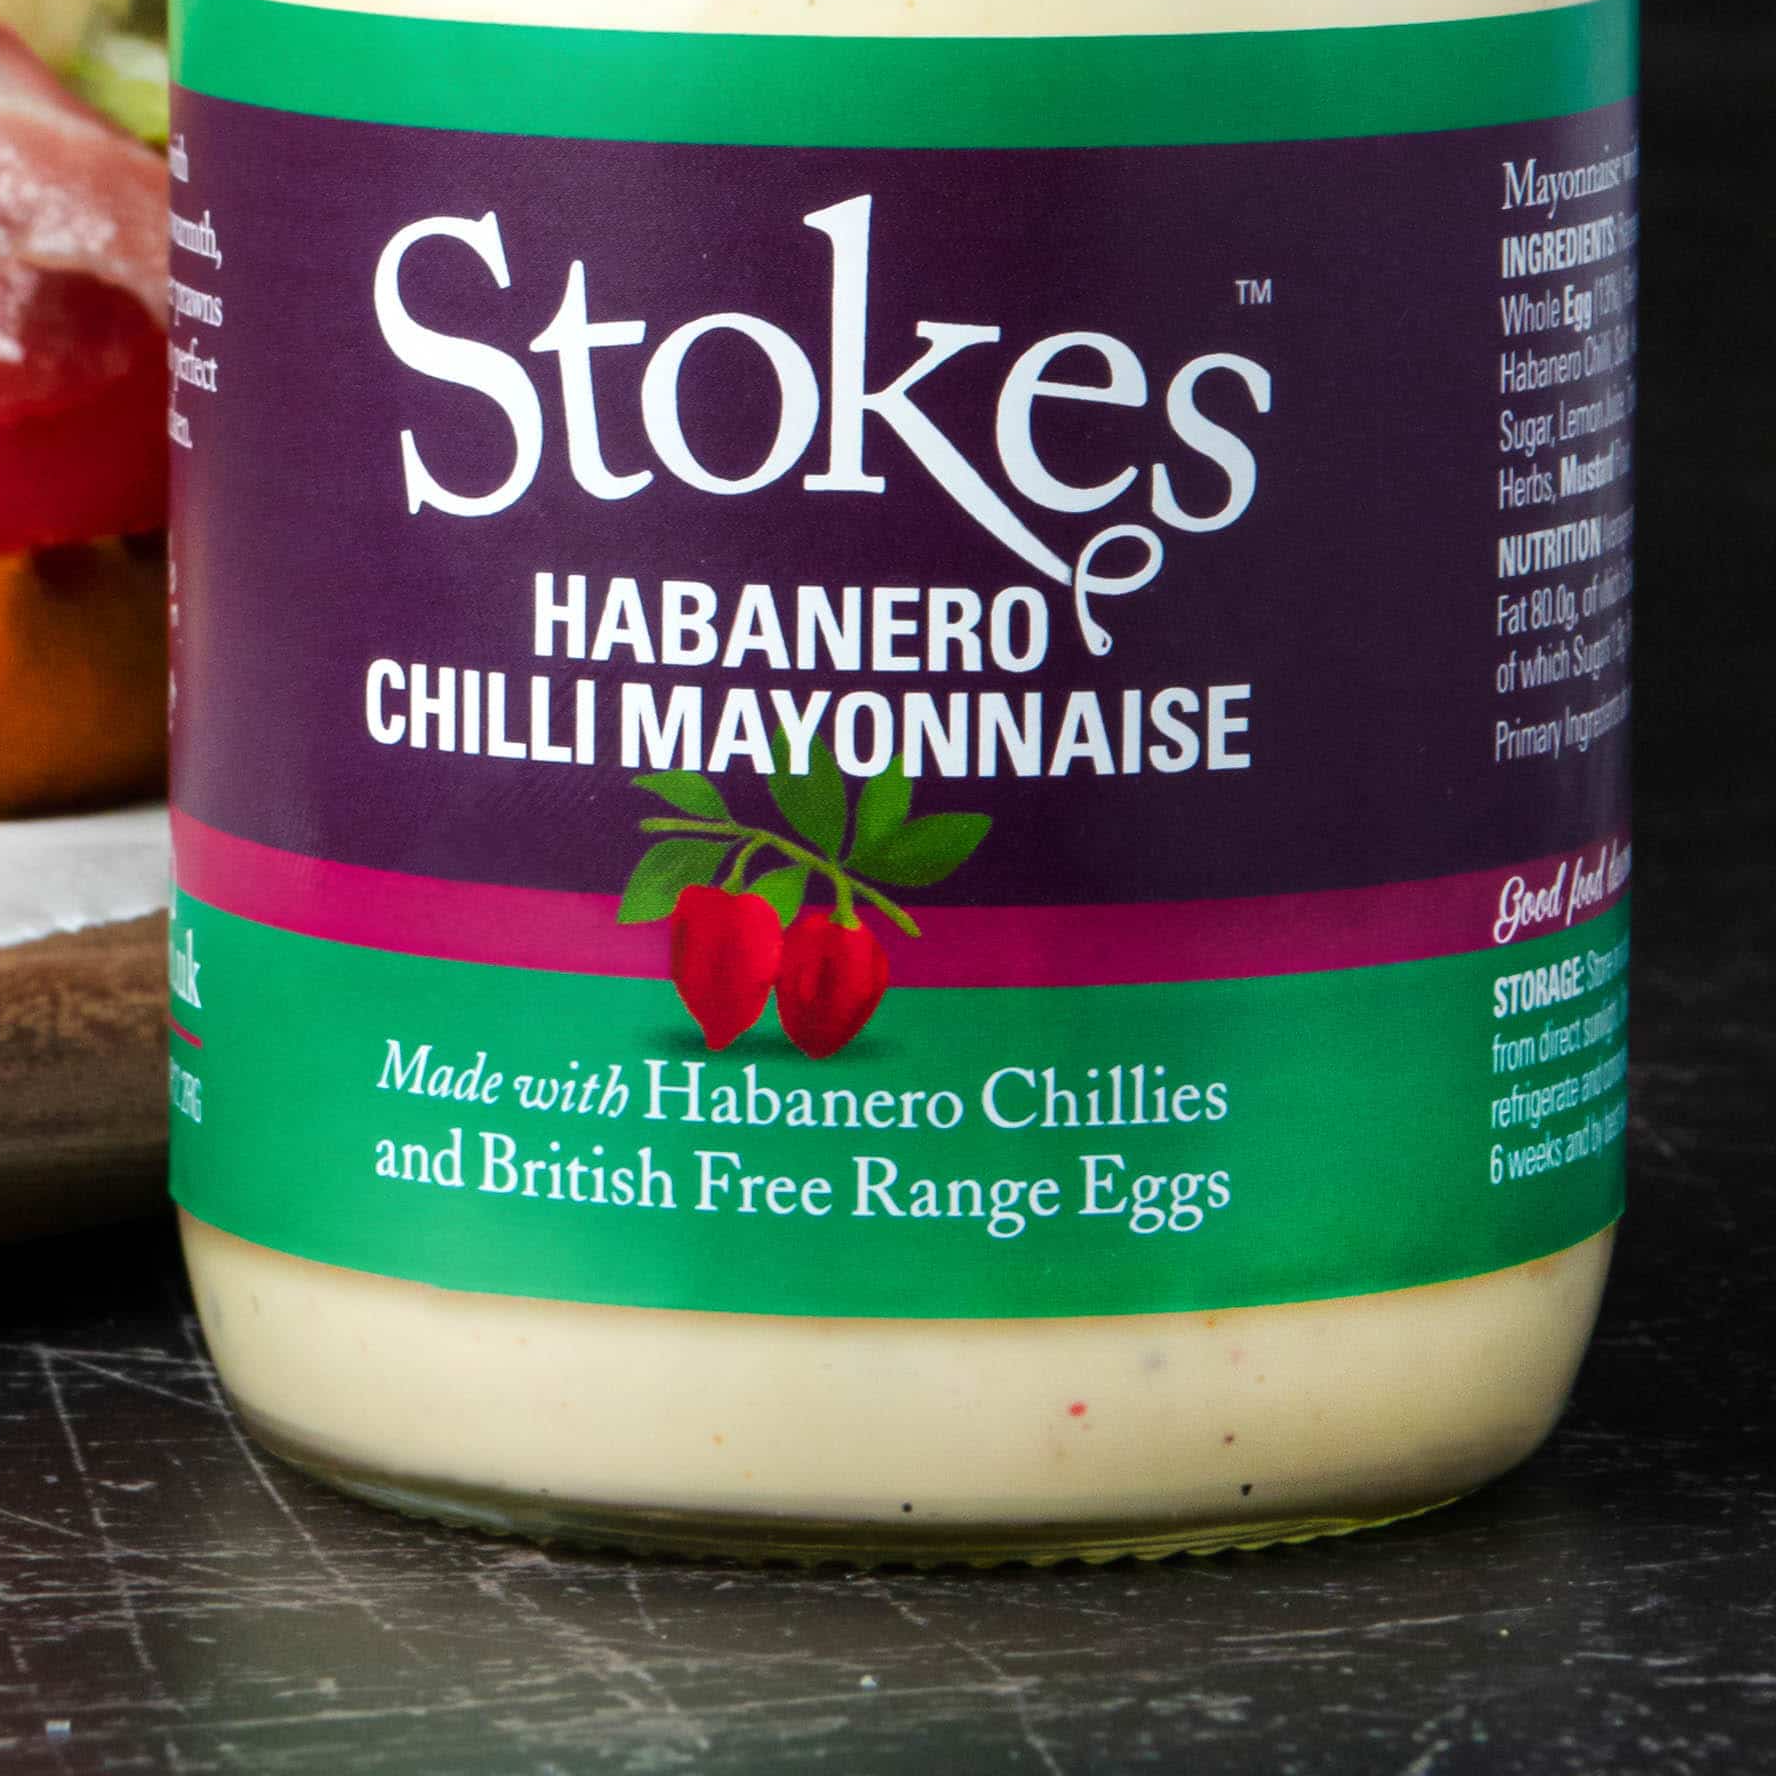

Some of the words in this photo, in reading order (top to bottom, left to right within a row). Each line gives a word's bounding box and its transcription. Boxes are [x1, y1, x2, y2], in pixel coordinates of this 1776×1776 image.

[1500, 144, 1621, 220] Mayonnaise
[1499, 289, 1561, 337] Whole
[1563, 284, 1593, 333] Egg
[1499, 348, 1582, 395] Habanero
[373, 193, 1272, 657] Stokes
[1499, 409, 1556, 458] Sugar,
[1498, 463, 1557, 511] Herbs,
[1497, 516, 1602, 578] NUTRITION
[532, 571, 1050, 674] HABANERO
[1496, 594, 1528, 637] Fat
[1496, 650, 1518, 694] of
[1520, 639, 1570, 690] which
[364, 657, 595, 766] CHILLI
[622, 683, 1252, 778] MAYONNAISE
[1495, 716, 1563, 763] Primary
[1493, 860, 1567, 945] Good
[1565, 844, 1608, 926] food
[1492, 1032, 1536, 1075] from
[1539, 1017, 1581, 1064] direct
[375, 1038, 504, 1105] Made
[513, 1060, 630, 1118] with
[642, 1058, 965, 1129] Habanero
[981, 1063, 1229, 1129] Chillies
[1490, 1079, 1580, 1131] refrigerate
[374, 1127, 465, 1188] and
[477, 1130, 678, 1209] British
[693, 1150, 833, 1216] Free
[851, 1155, 1061, 1239] Range
[1078, 1154, 1231, 1235] Eggs
[1489, 1144, 1504, 1186] 6
[1507, 1131, 1565, 1181] weeks
